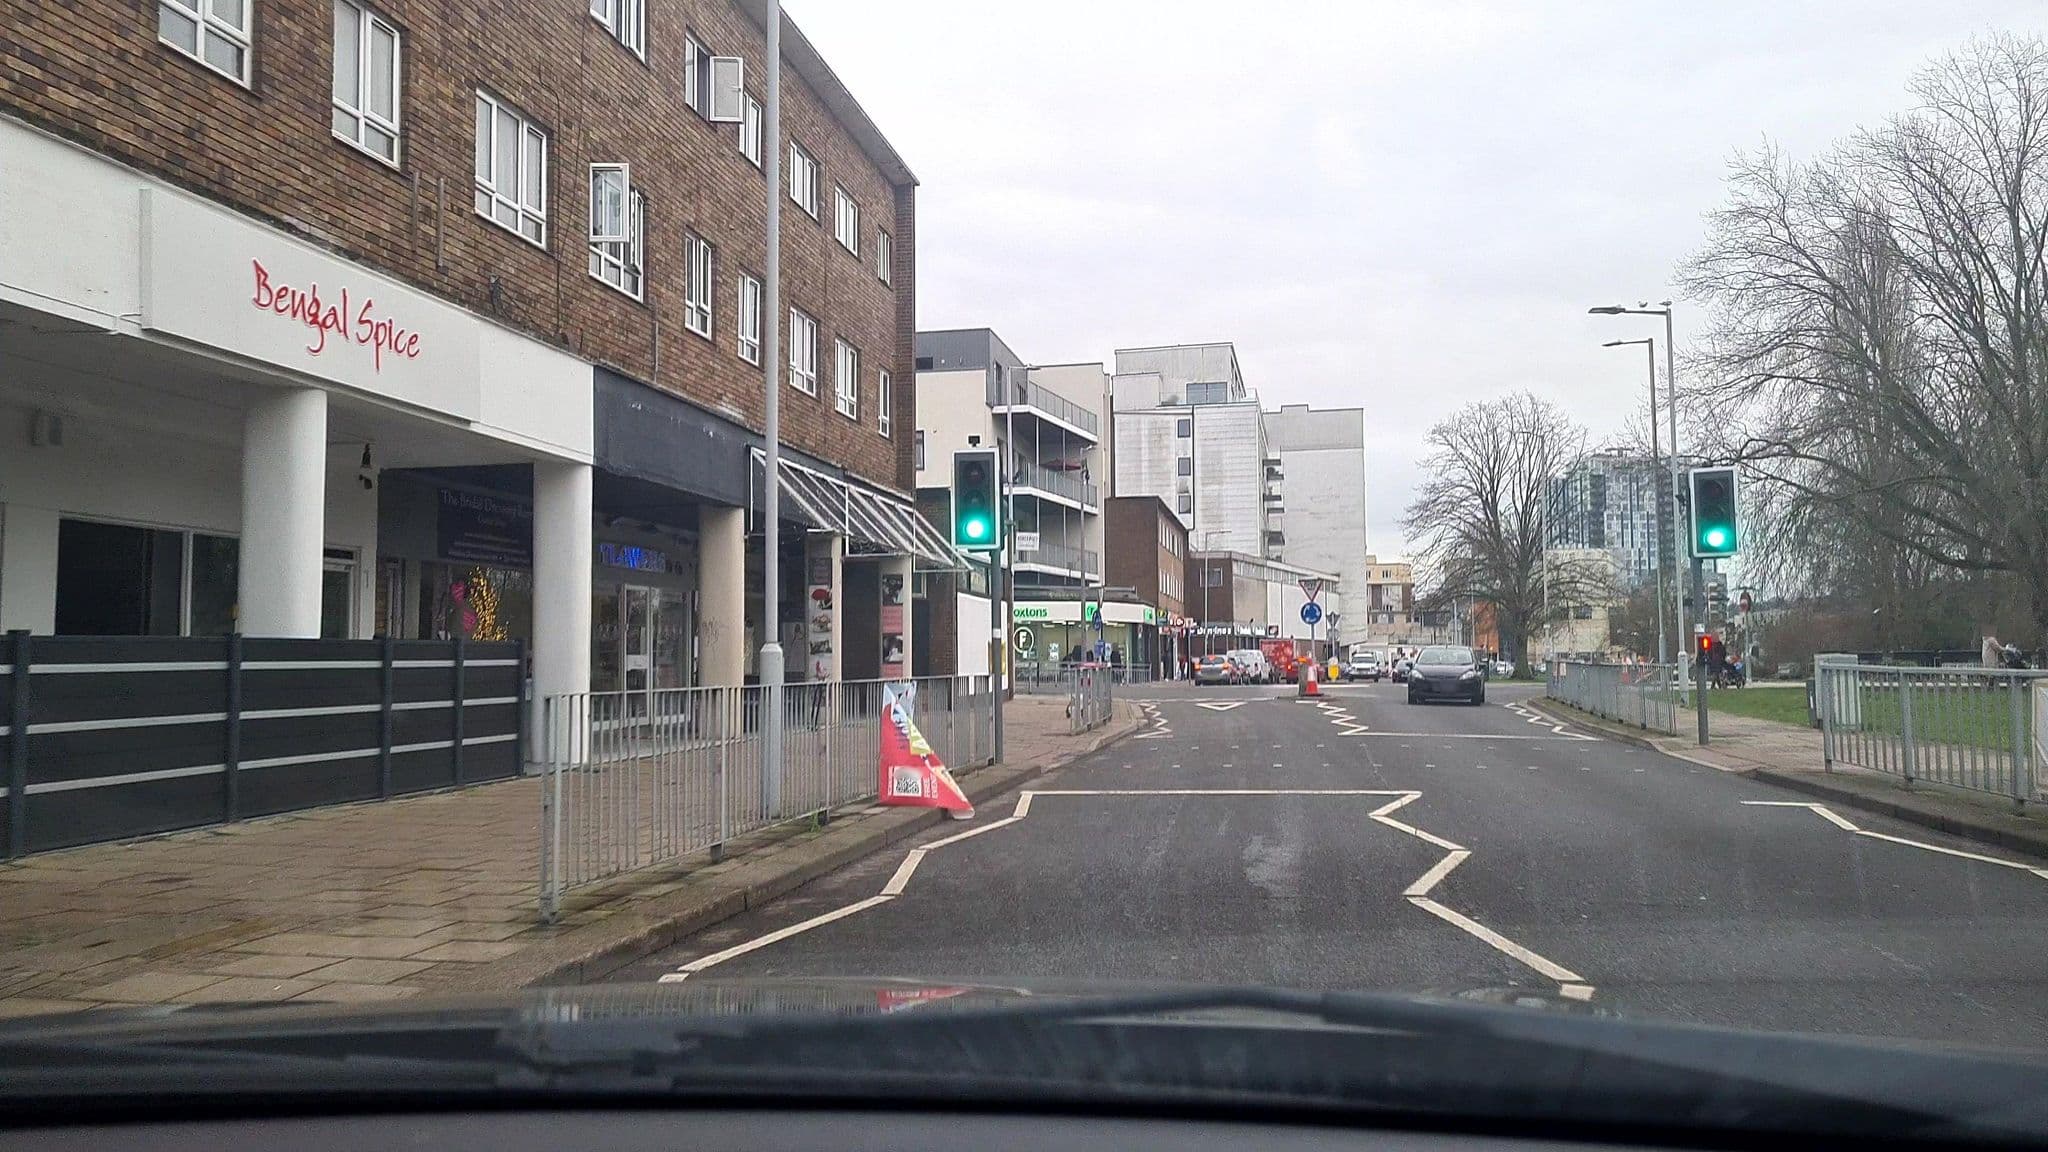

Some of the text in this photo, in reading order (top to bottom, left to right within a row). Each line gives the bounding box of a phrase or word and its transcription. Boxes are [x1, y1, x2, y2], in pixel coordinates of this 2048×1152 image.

[252, 257, 420, 373] Bengal Spice
[1013, 607, 1048, 618] oxtons
